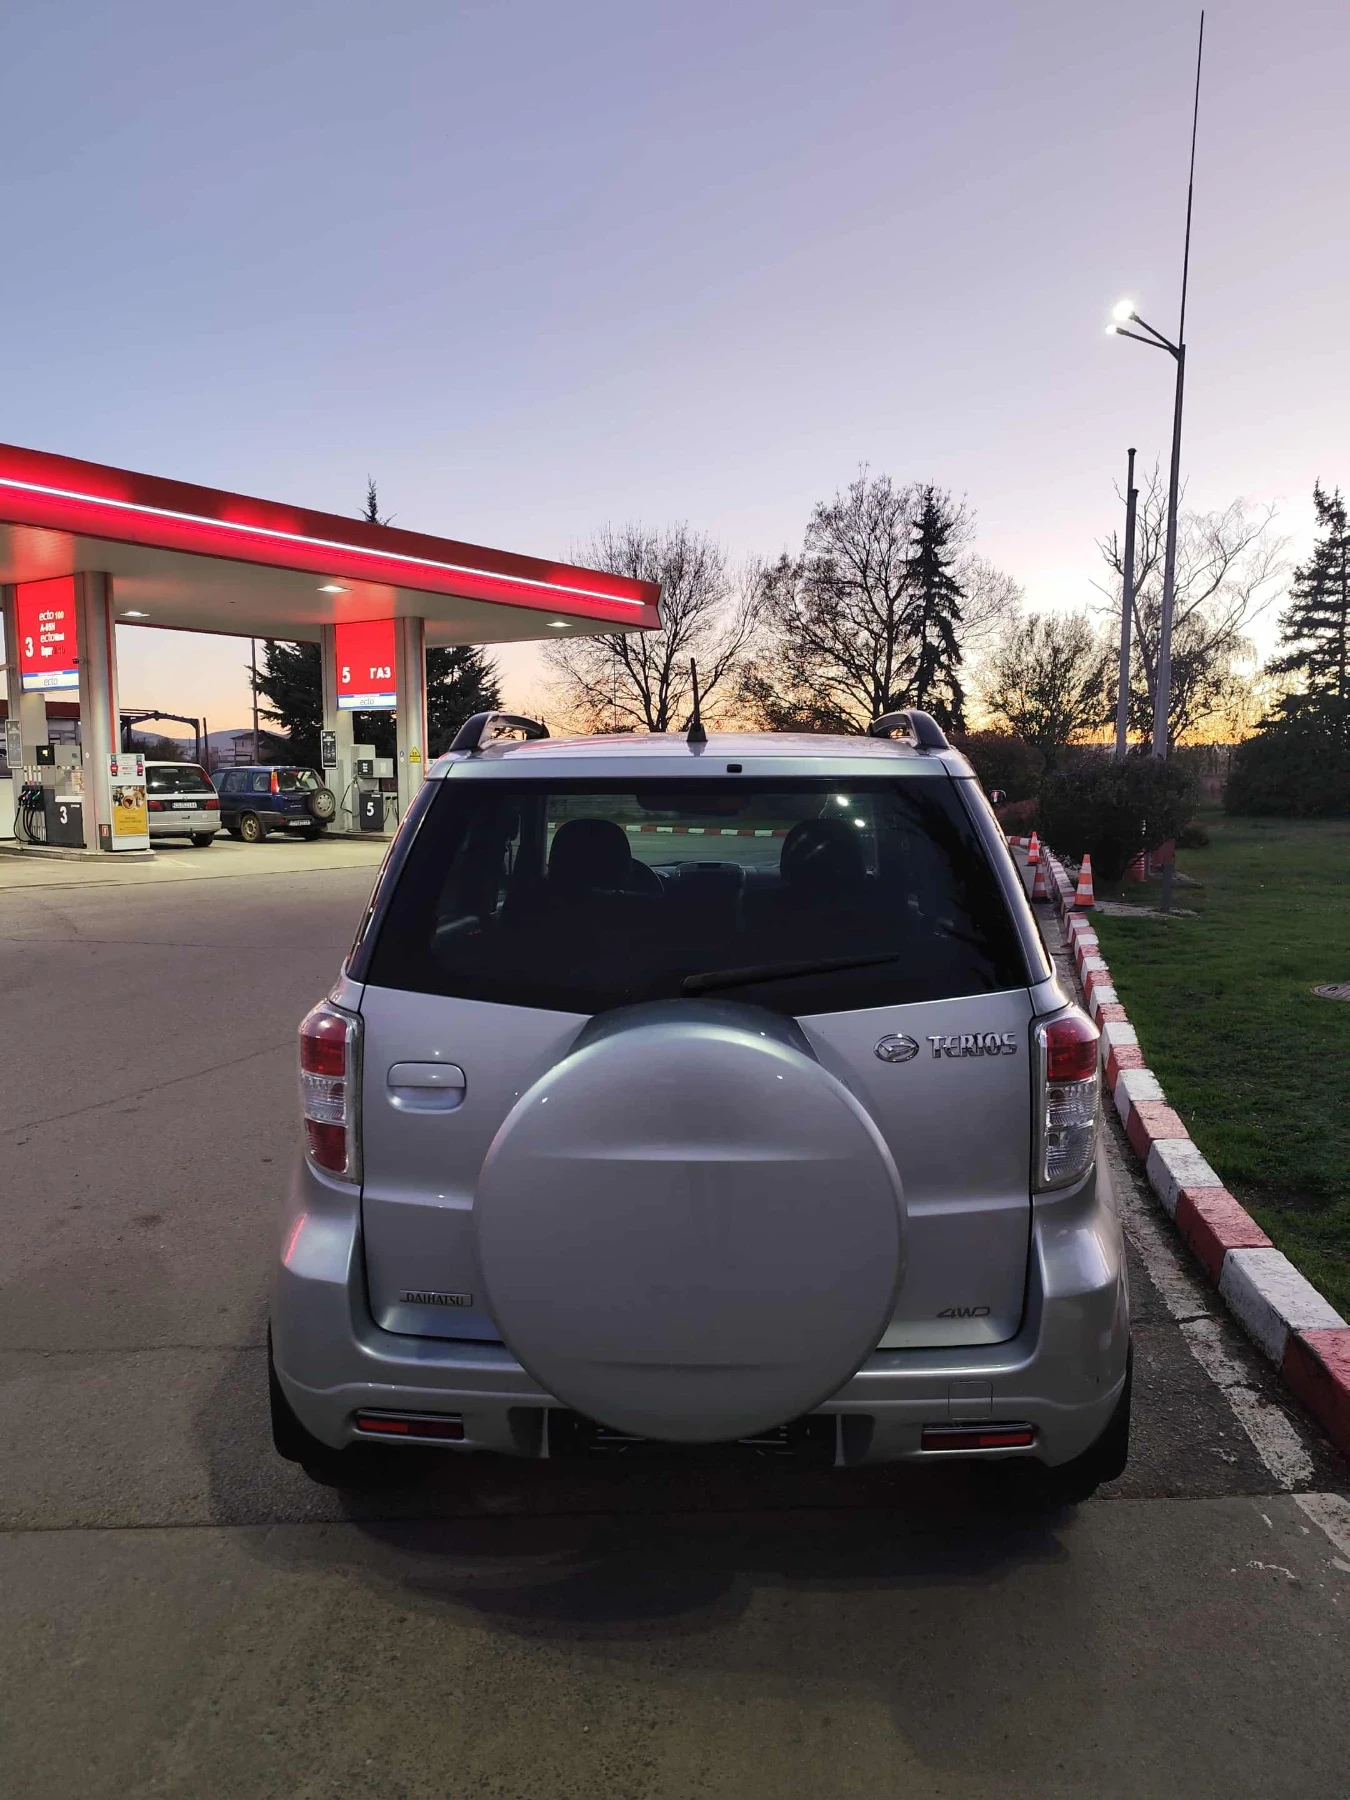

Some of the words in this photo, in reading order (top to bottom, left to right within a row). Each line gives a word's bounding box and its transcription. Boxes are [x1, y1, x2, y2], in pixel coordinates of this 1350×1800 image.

[25, 637, 34, 657] 3
[341, 666, 351, 684] 5
[369, 666, 391, 679] ГАЗ
[60, 805, 68, 824] 3
[366, 802, 374, 816] 5
[926, 1032, 1018, 1059] TERIOS
[406, 1293, 464, 1306] DAIHATSU
[936, 1306, 991, 1319] 4WD
